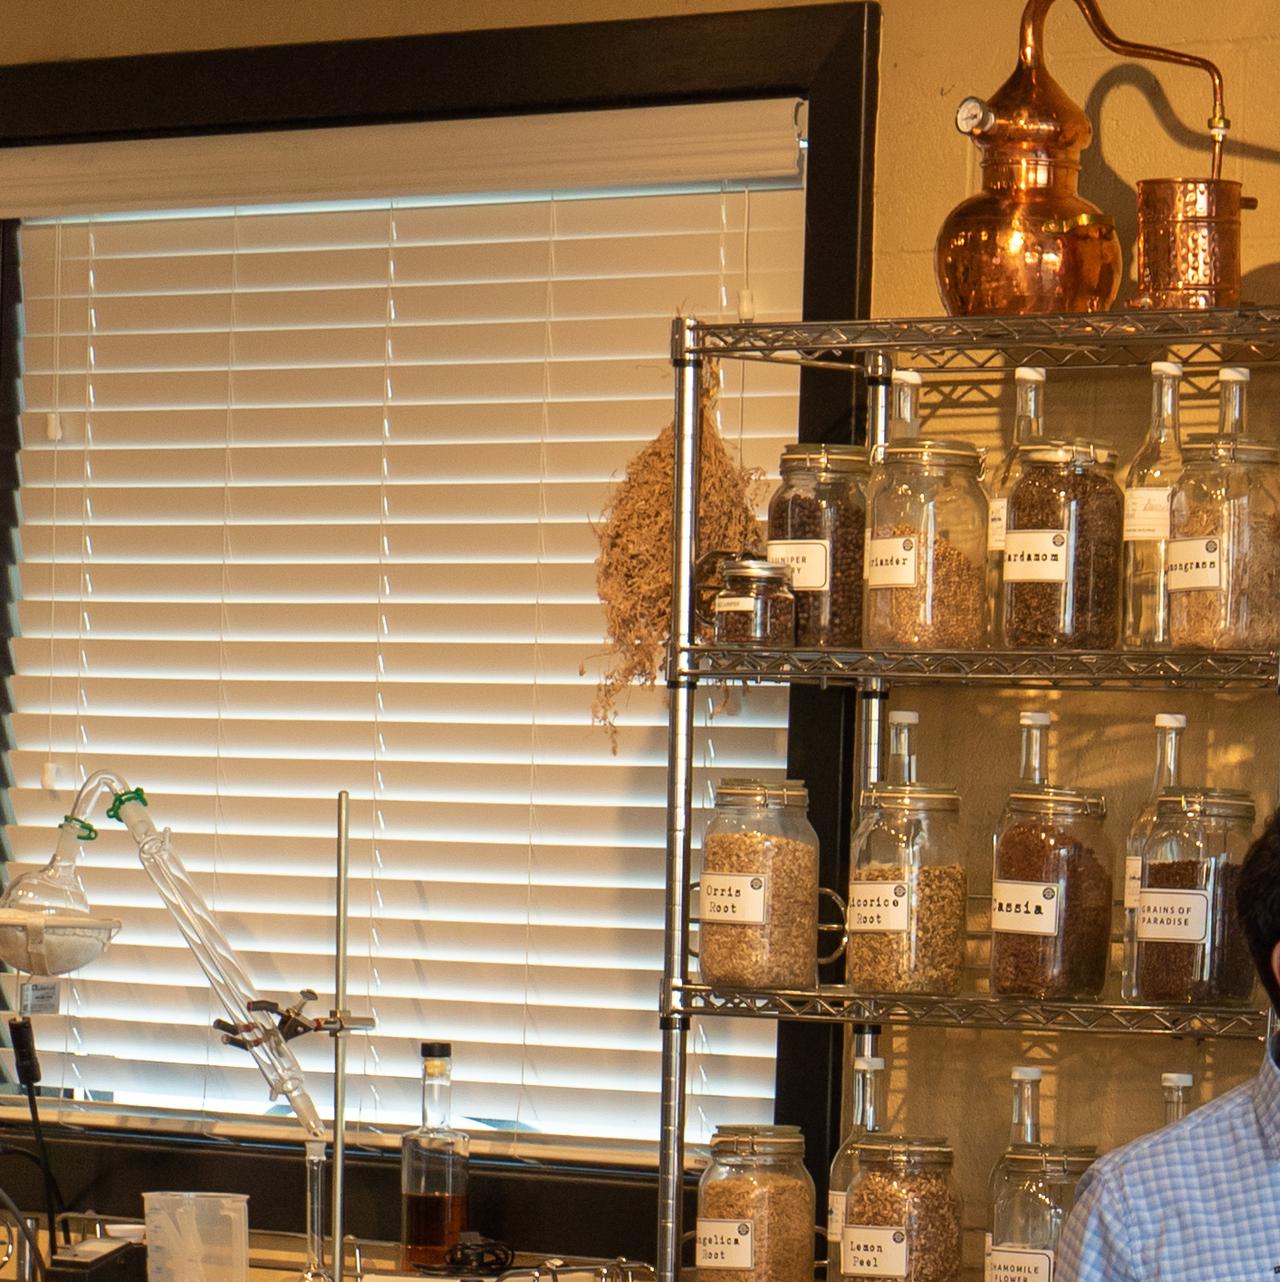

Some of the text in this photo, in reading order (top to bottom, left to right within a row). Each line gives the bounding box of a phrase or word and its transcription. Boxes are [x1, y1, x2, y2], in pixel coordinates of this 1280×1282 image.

[870, 556, 908, 568] riander
[1004, 550, 1060, 562] ardamom
[706, 885, 742, 898] Orris
[709, 901, 738, 914] Root
[850, 895, 900, 908] icorice
[1142, 904, 1192, 916] GRAINS OF
[856, 912, 883, 925] Root
[1142, 915, 1191, 927] PARADISE
[697, 1235, 741, 1247] ngelica
[850, 1240, 884, 1254] Lemon
[702, 1249, 726, 1261] Root
[853, 1256, 879, 1268] Peel
[991, 1264, 1039, 1275] HAMOMILE
